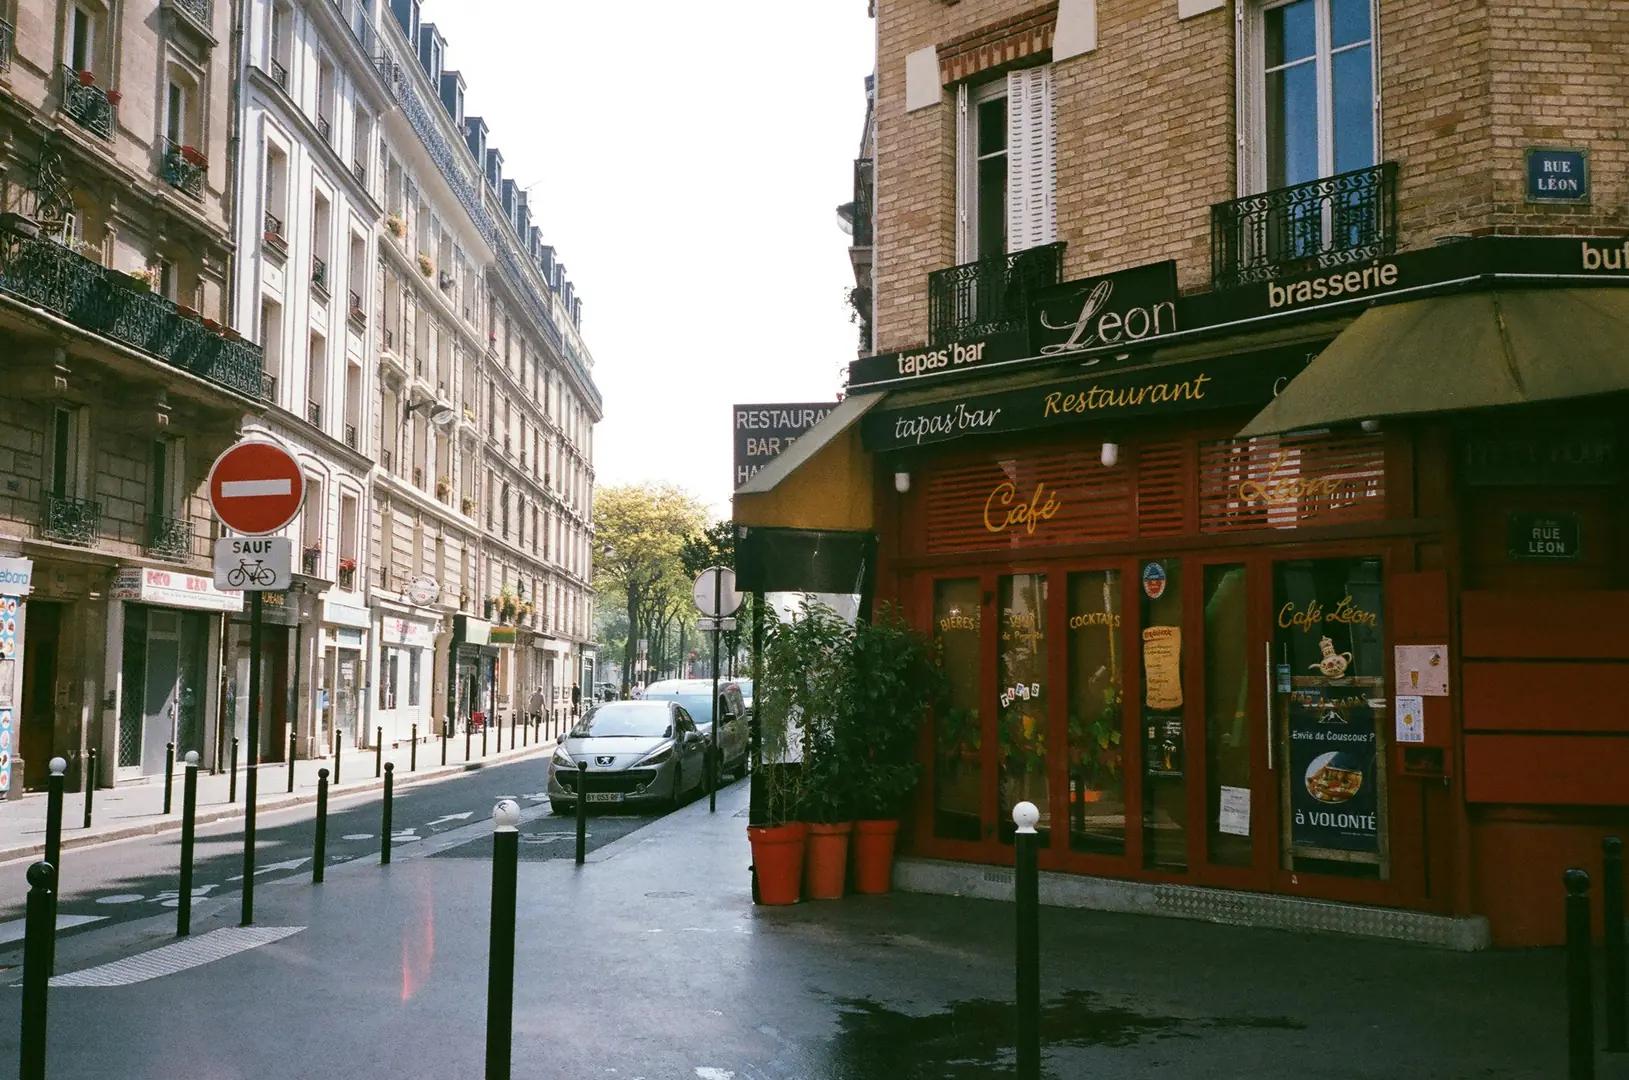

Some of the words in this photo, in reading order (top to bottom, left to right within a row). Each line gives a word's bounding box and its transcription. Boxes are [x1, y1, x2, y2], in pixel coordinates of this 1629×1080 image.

[1543, 160, 1571, 173] RUE
[1537, 175, 1578, 191] LÉON
[1268, 260, 1399, 309] brasserie
[1039, 279, 1177, 356] Leon
[897, 341, 986, 376] tapas'bar
[1043, 373, 1211, 418] Restaurant
[736, 409, 832, 429] RESTAURA
[894, 405, 1001, 444] tapas'bar
[746, 437, 786, 456] BAR
[983, 482, 1060, 534] Café
[1532, 527, 1561, 540] RUE
[232, 540, 273, 554] SAUF
[1528, 540, 1566, 554] LÉON
[1069, 612, 1121, 630] COCKTAILS
[1278, 599, 1322, 633] Café
[1325, 595, 1377, 627] Léon
[1292, 730, 1314, 741] Envie
[1315, 731, 1325, 741] de
[1326, 731, 1368, 743] Couscous
[1295, 808, 1305, 825] à
[1308, 811, 1377, 831] VOLONTÉ
